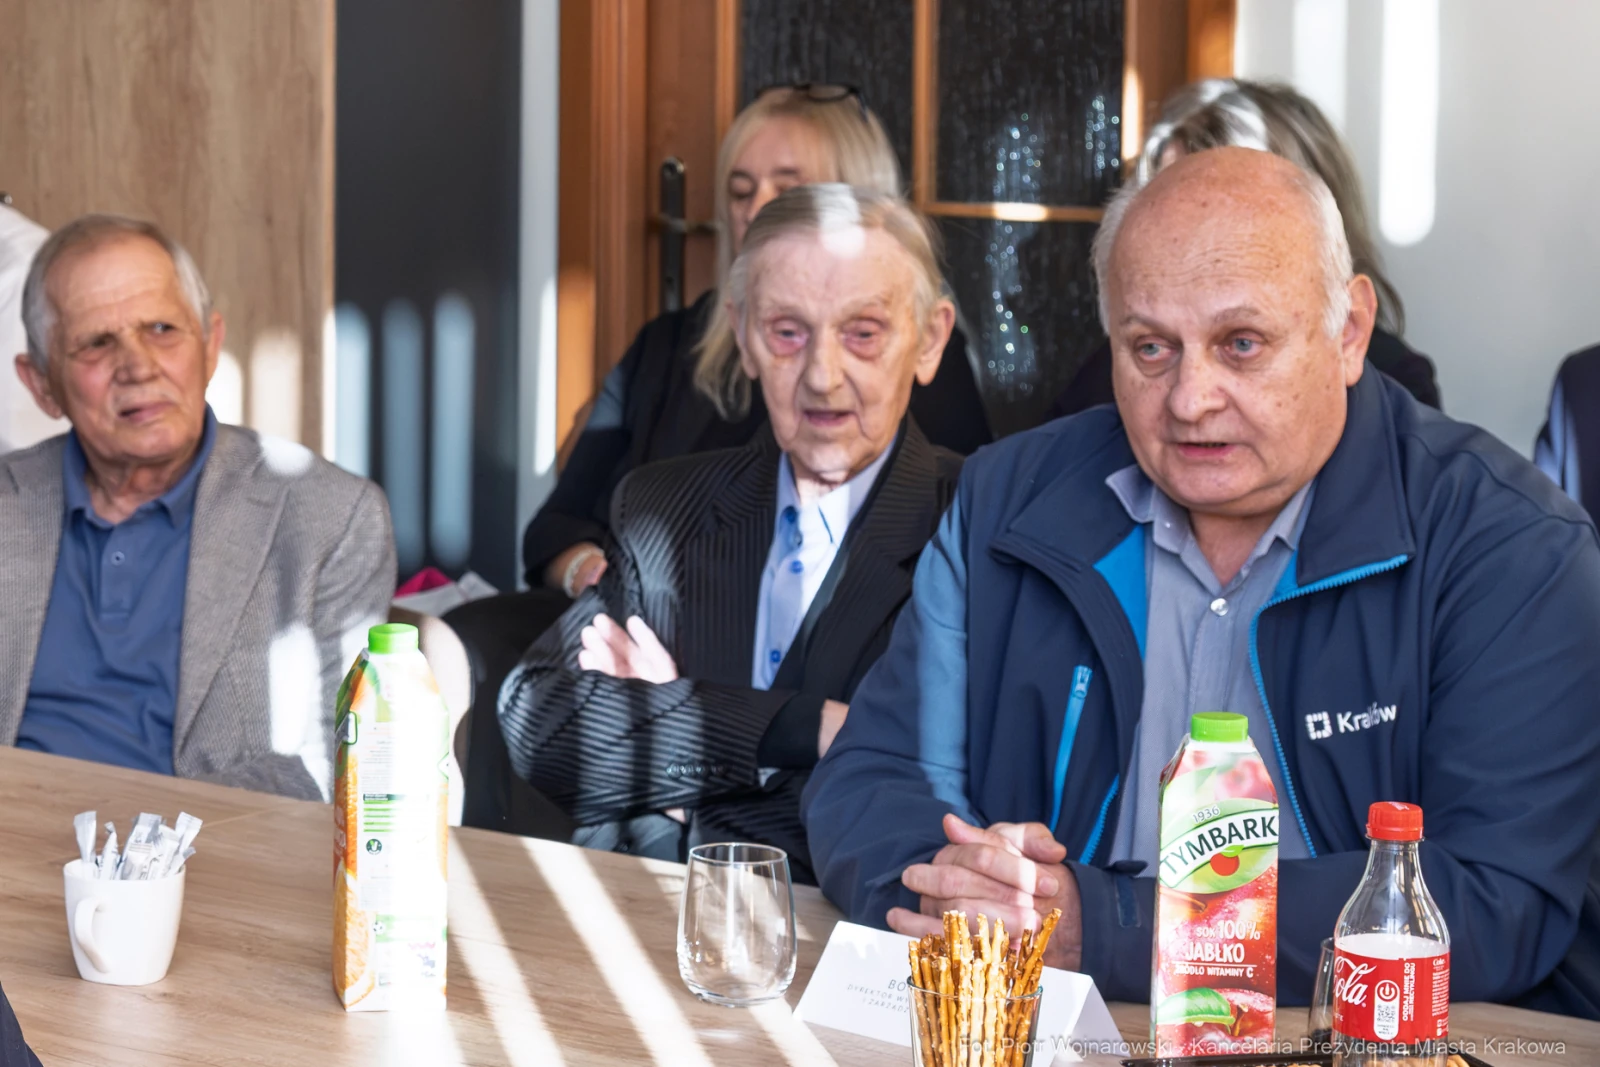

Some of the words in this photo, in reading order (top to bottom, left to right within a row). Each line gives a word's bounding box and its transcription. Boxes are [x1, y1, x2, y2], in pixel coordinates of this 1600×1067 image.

[1336, 701, 1397, 733] Kraków
[1193, 806, 1220, 822] 1936
[1163, 816, 1279, 875] TYMBARK
[1218, 920, 1260, 940] 100%
[1186, 942, 1245, 963] JABŁKO
[1207, 967, 1244, 978] WITAMINY
[1246, 967, 1254, 979] C
[1404, 962, 1410, 974] DO
